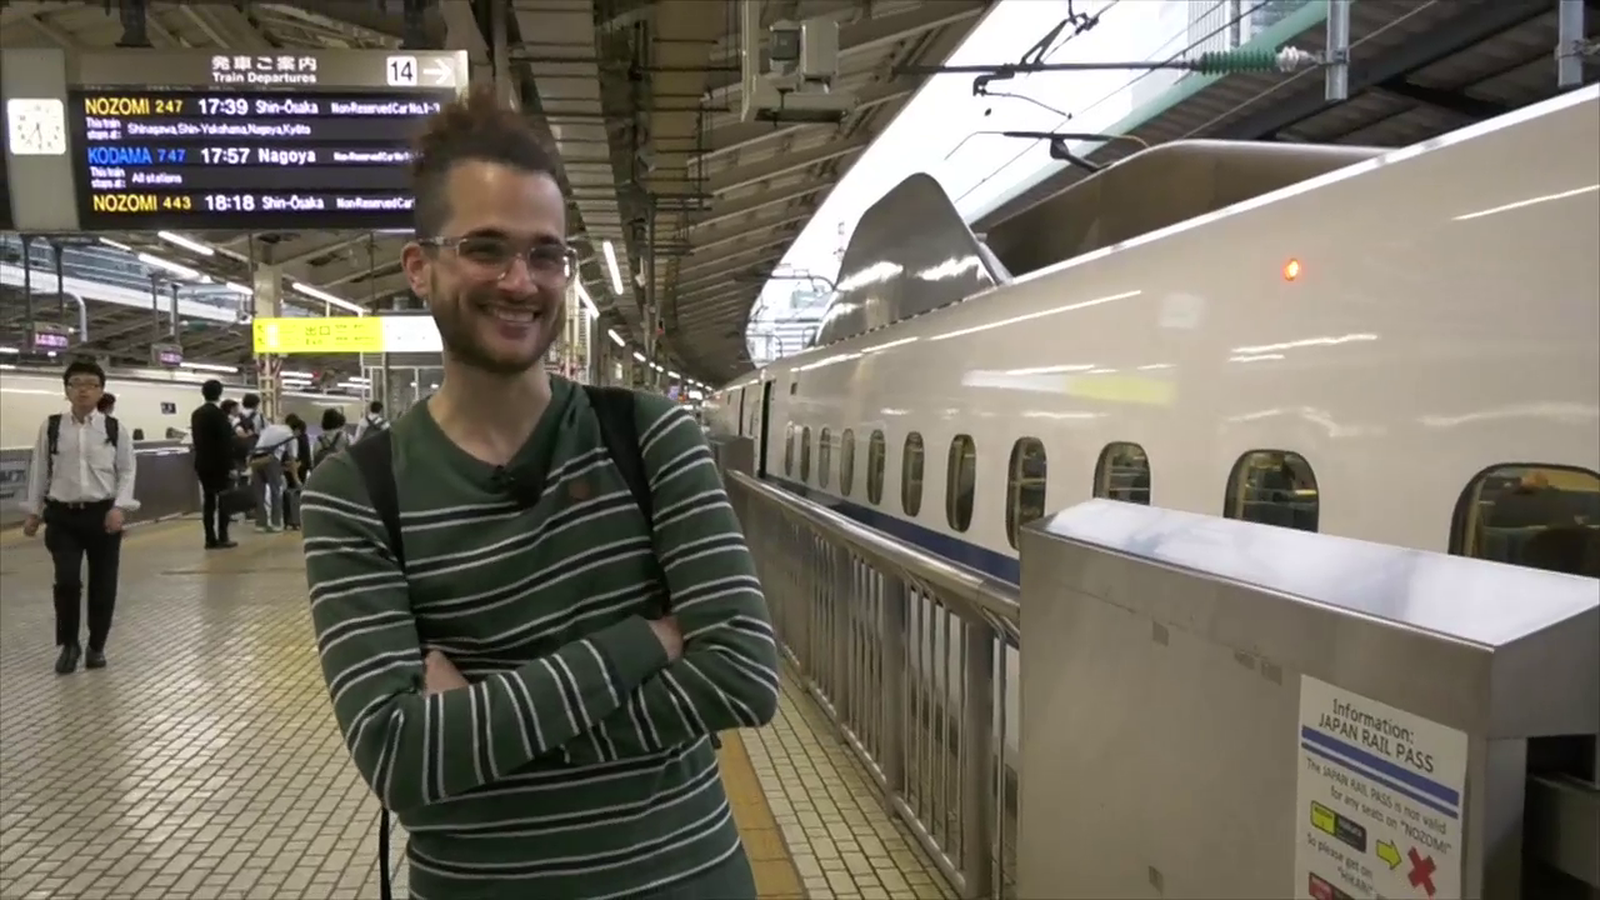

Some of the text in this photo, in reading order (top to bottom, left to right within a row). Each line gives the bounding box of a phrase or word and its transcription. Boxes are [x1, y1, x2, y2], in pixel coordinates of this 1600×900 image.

[211, 55, 317, 71] 発車ご案内
[390, 61, 414, 82] 14
[212, 72, 317, 84] Train Departures
[84, 98, 150, 115] NOZOMI
[155, 99, 183, 114] 247
[198, 98, 249, 115] 17:39
[86, 116, 102, 128] This
[87, 147, 153, 164] KODAMA
[157, 149, 186, 162] 747
[201, 147, 251, 164] 17:57
[258, 147, 316, 165] Nagoya
[90, 165, 107, 177] This
[131, 172, 183, 184] All stations
[93, 194, 158, 211] NOZOMI
[162, 196, 192, 210] 443
[205, 194, 256, 211] 18:18
[305, 325, 331, 336] 出口
[1333, 698, 1414, 744] Information:
[1319, 713, 1435, 773] JAPAN RAIL PASS
[1306, 757, 1447, 835] The JAPAN RAIL PASS is not valid
[1331, 785, 1343, 803] for
[1344, 793, 1360, 811] any
[1361, 802, 1384, 823] seats
[1386, 817, 1398, 831] on
[1317, 840, 1344, 862] please
